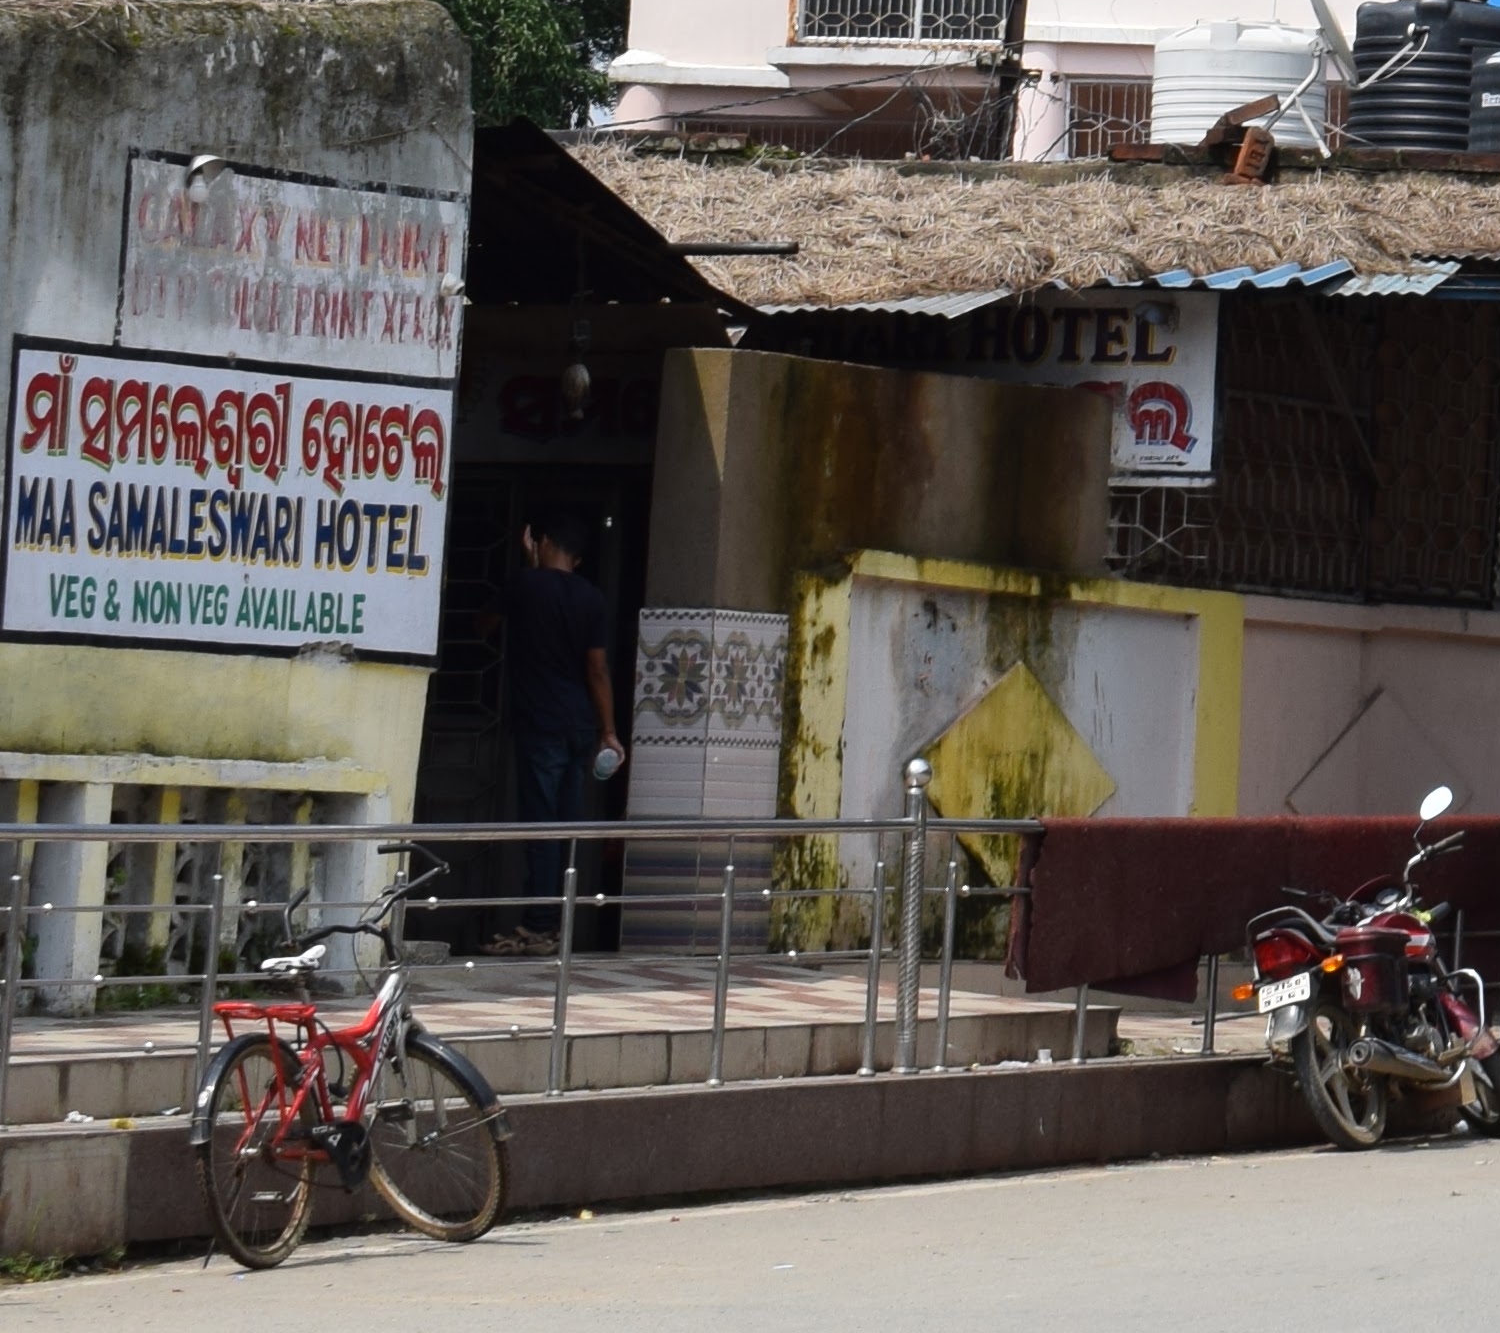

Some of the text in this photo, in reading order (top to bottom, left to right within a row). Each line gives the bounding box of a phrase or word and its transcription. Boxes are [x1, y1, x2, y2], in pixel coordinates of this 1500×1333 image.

[294, 285, 373, 341] PRINT
[967, 307, 1176, 364] HOTEL
[20, 354, 78, 456] ମାଁ
[14, 475, 429, 575] MAA SAMALESWARI HOTEL
[49, 574, 366, 634] VEG & NON VEG AVAILABLE
